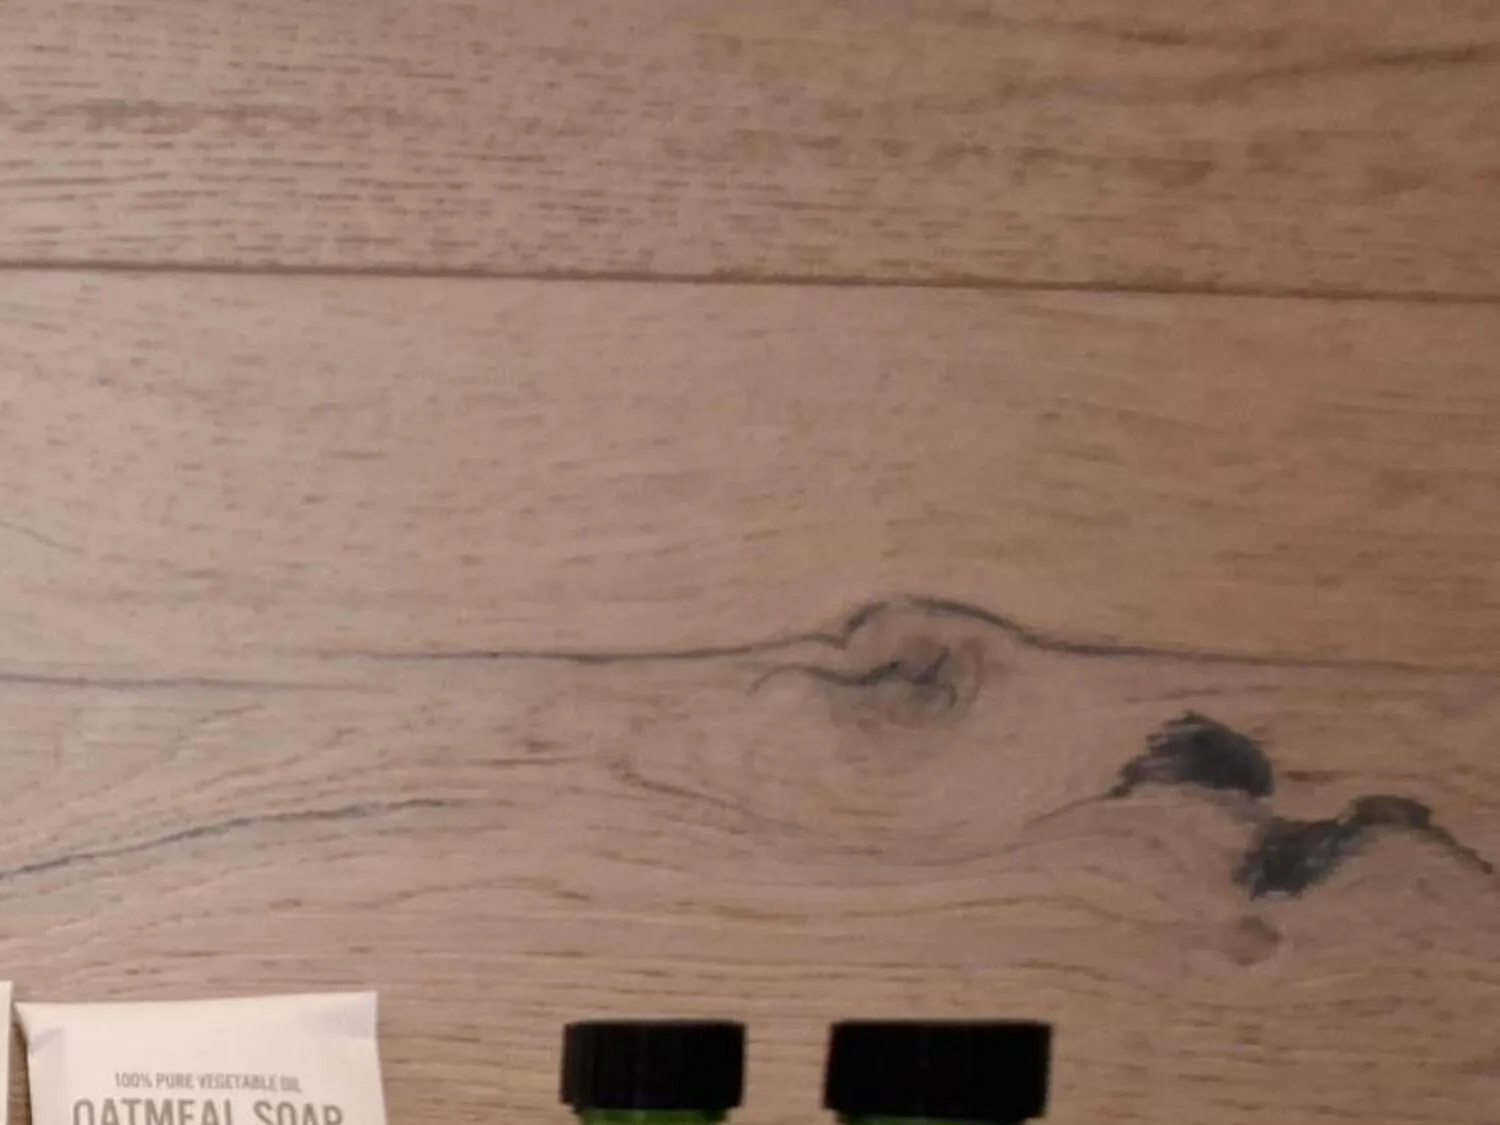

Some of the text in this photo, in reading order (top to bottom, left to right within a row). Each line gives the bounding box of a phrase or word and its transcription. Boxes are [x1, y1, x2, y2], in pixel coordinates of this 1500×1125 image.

[114, 1072, 303, 1093] 100% PURE VEGETABLE OIL
